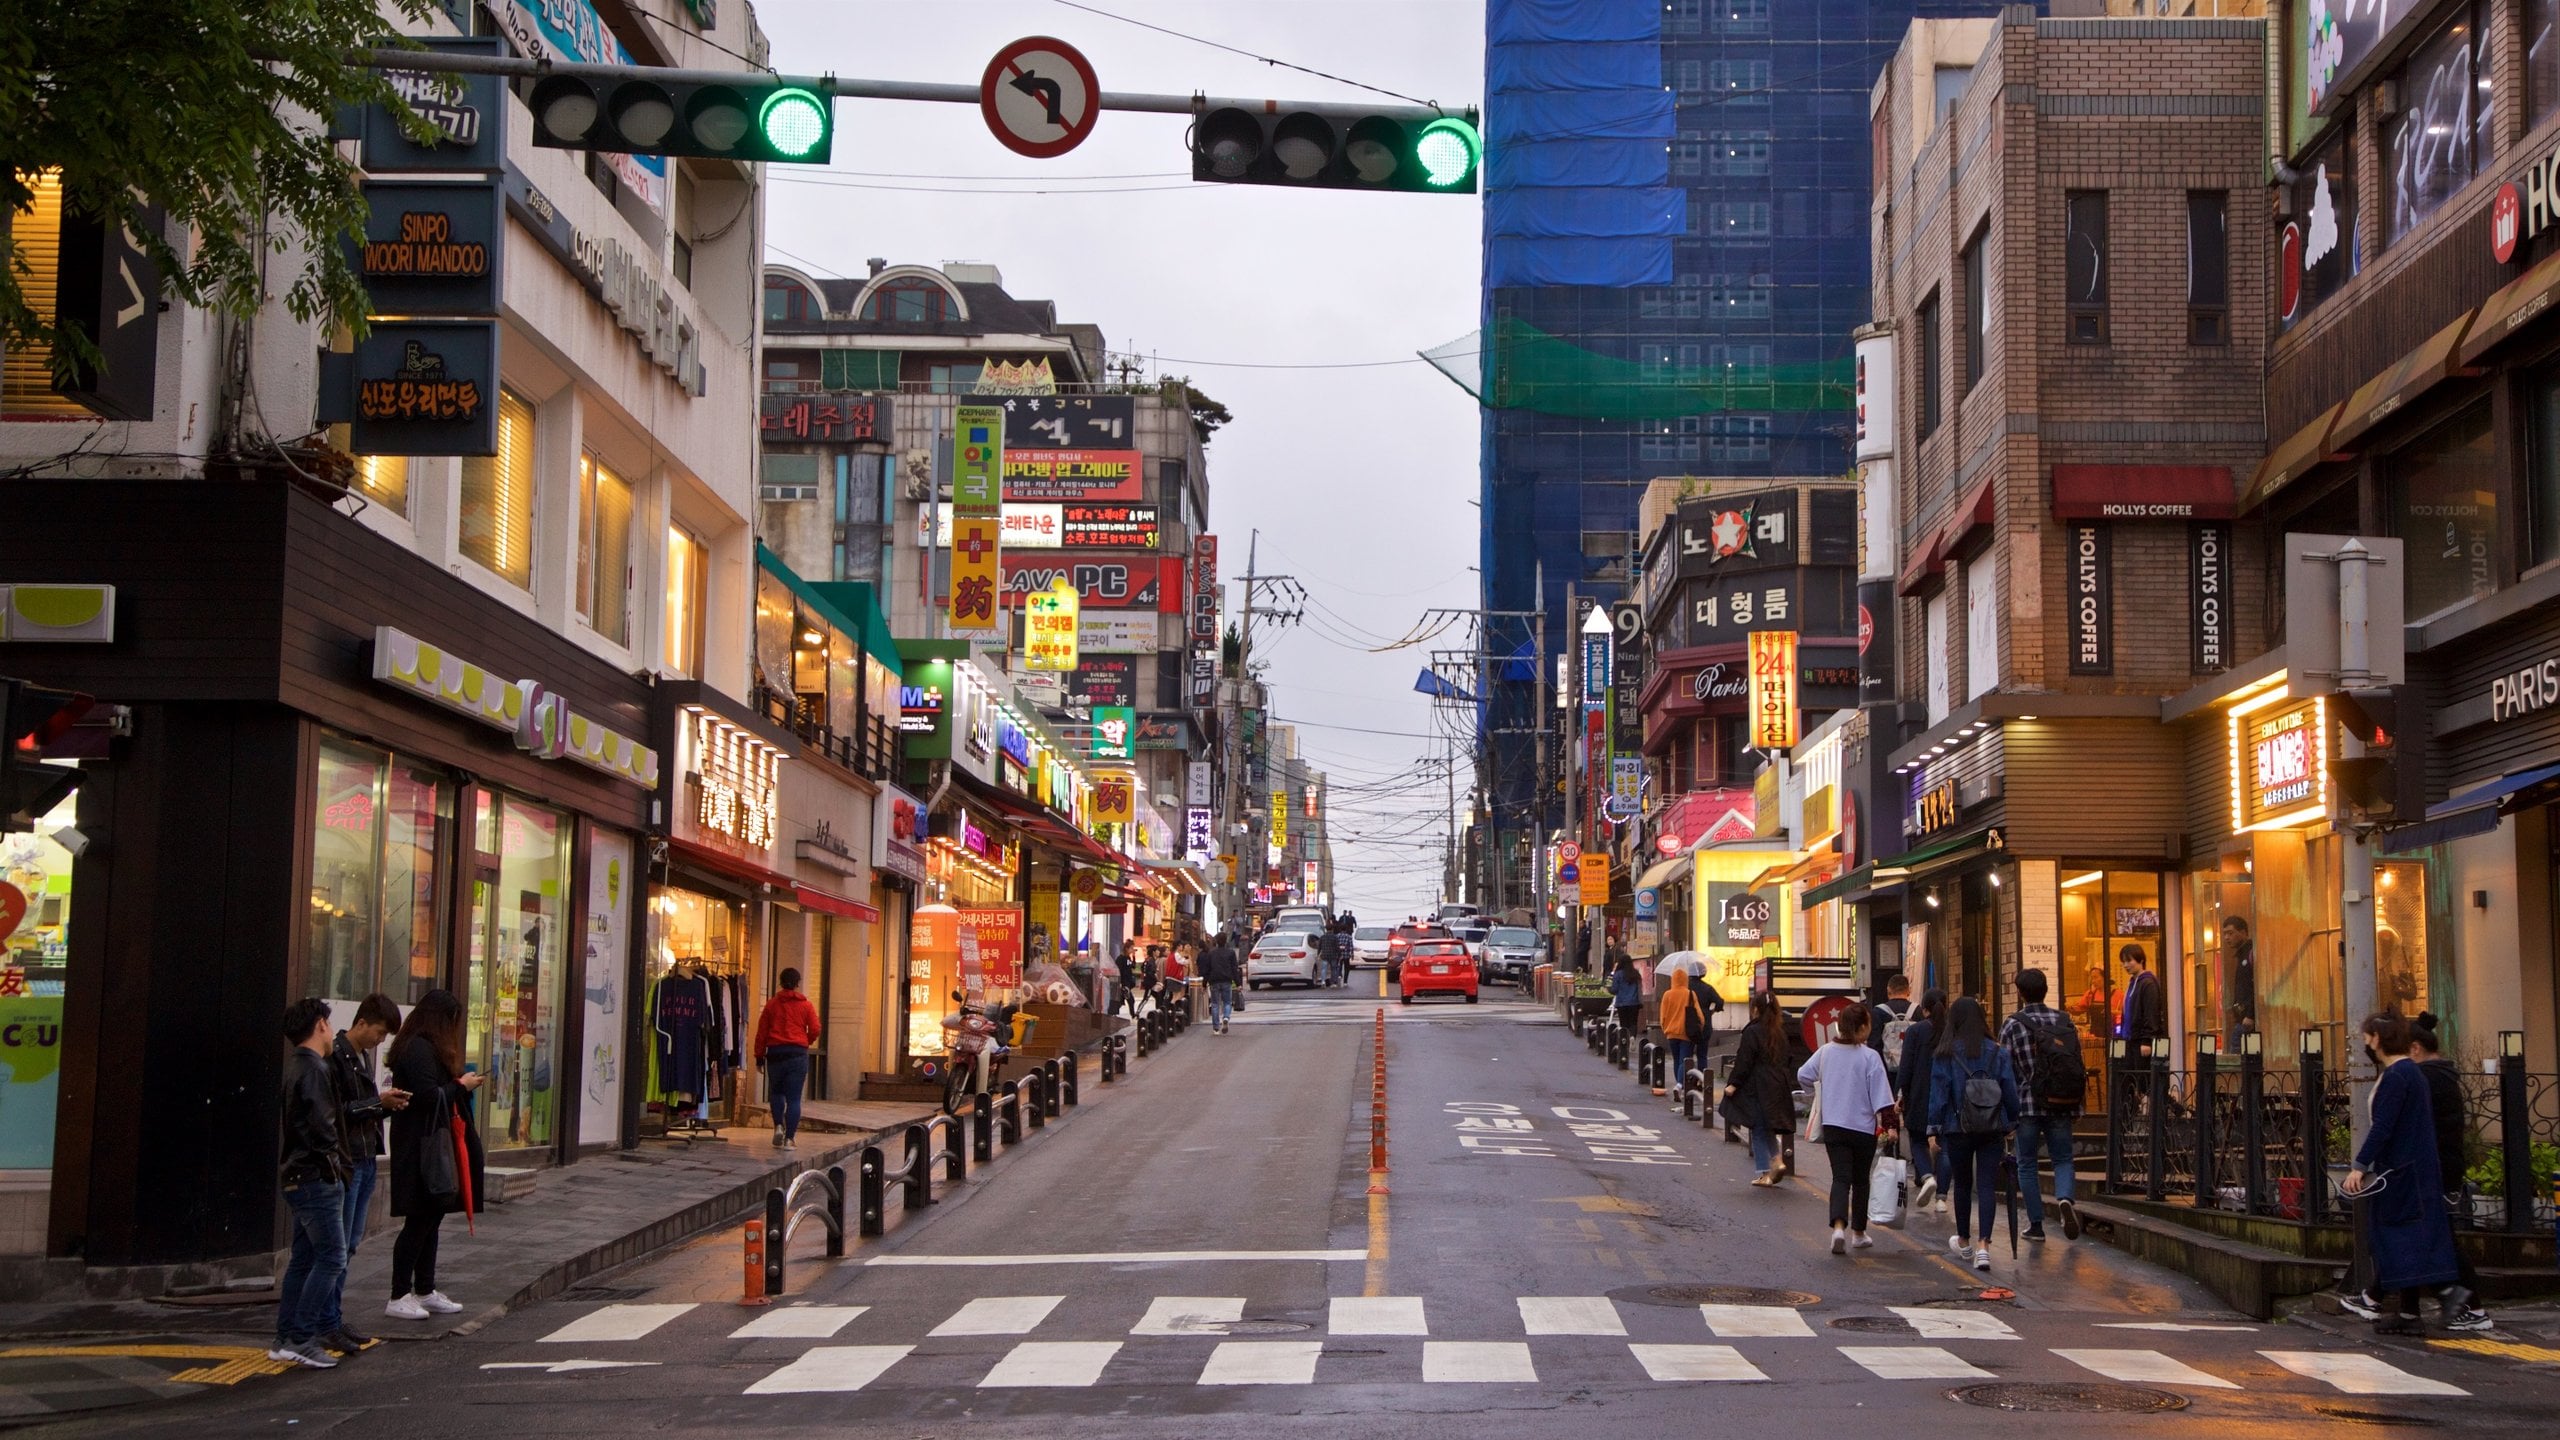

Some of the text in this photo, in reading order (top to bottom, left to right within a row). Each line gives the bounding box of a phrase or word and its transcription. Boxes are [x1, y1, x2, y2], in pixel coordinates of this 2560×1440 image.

[402, 213, 448, 244] SINPO
[364, 244, 485, 273] WOORI MANDOO
[1005, 416, 1123, 446] 석기
[964, 446, 993, 501] 약국
[1055, 462, 1132, 478] 업그레이드
[1000, 515, 1056, 535] 래타운
[2103, 504, 2193, 516] HOLLYS COFFEE
[1073, 563, 1128, 598] PC
[954, 575, 993, 621] 药
[1137, 589, 1155, 603] 4F
[1696, 587, 1789, 628] 대형룸
[2079, 528, 2098, 664] HOLLYS COFFEE
[2201, 529, 2219, 665] HOLLYS COFFEE
[1194, 593, 1214, 636] PC
[1616, 607, 1641, 646] 9
[1617, 652, 1641, 662] Nine
[1695, 663, 1748, 700] Paris
[2492, 659, 2558, 722] PARIS
[1115, 694, 1128, 706] 3F
[1761, 680, 1787, 742] 편의점
[900, 716, 923, 724] armacy
[1274, 793, 1285, 846] 번개포차
[1564, 847, 1576, 857] 30
[995, 912, 1016, 928] 도매
[1718, 899, 1770, 925] J168
[1727, 928, 1761, 940] 饰品店
[2, 1024, 58, 1048] CU
